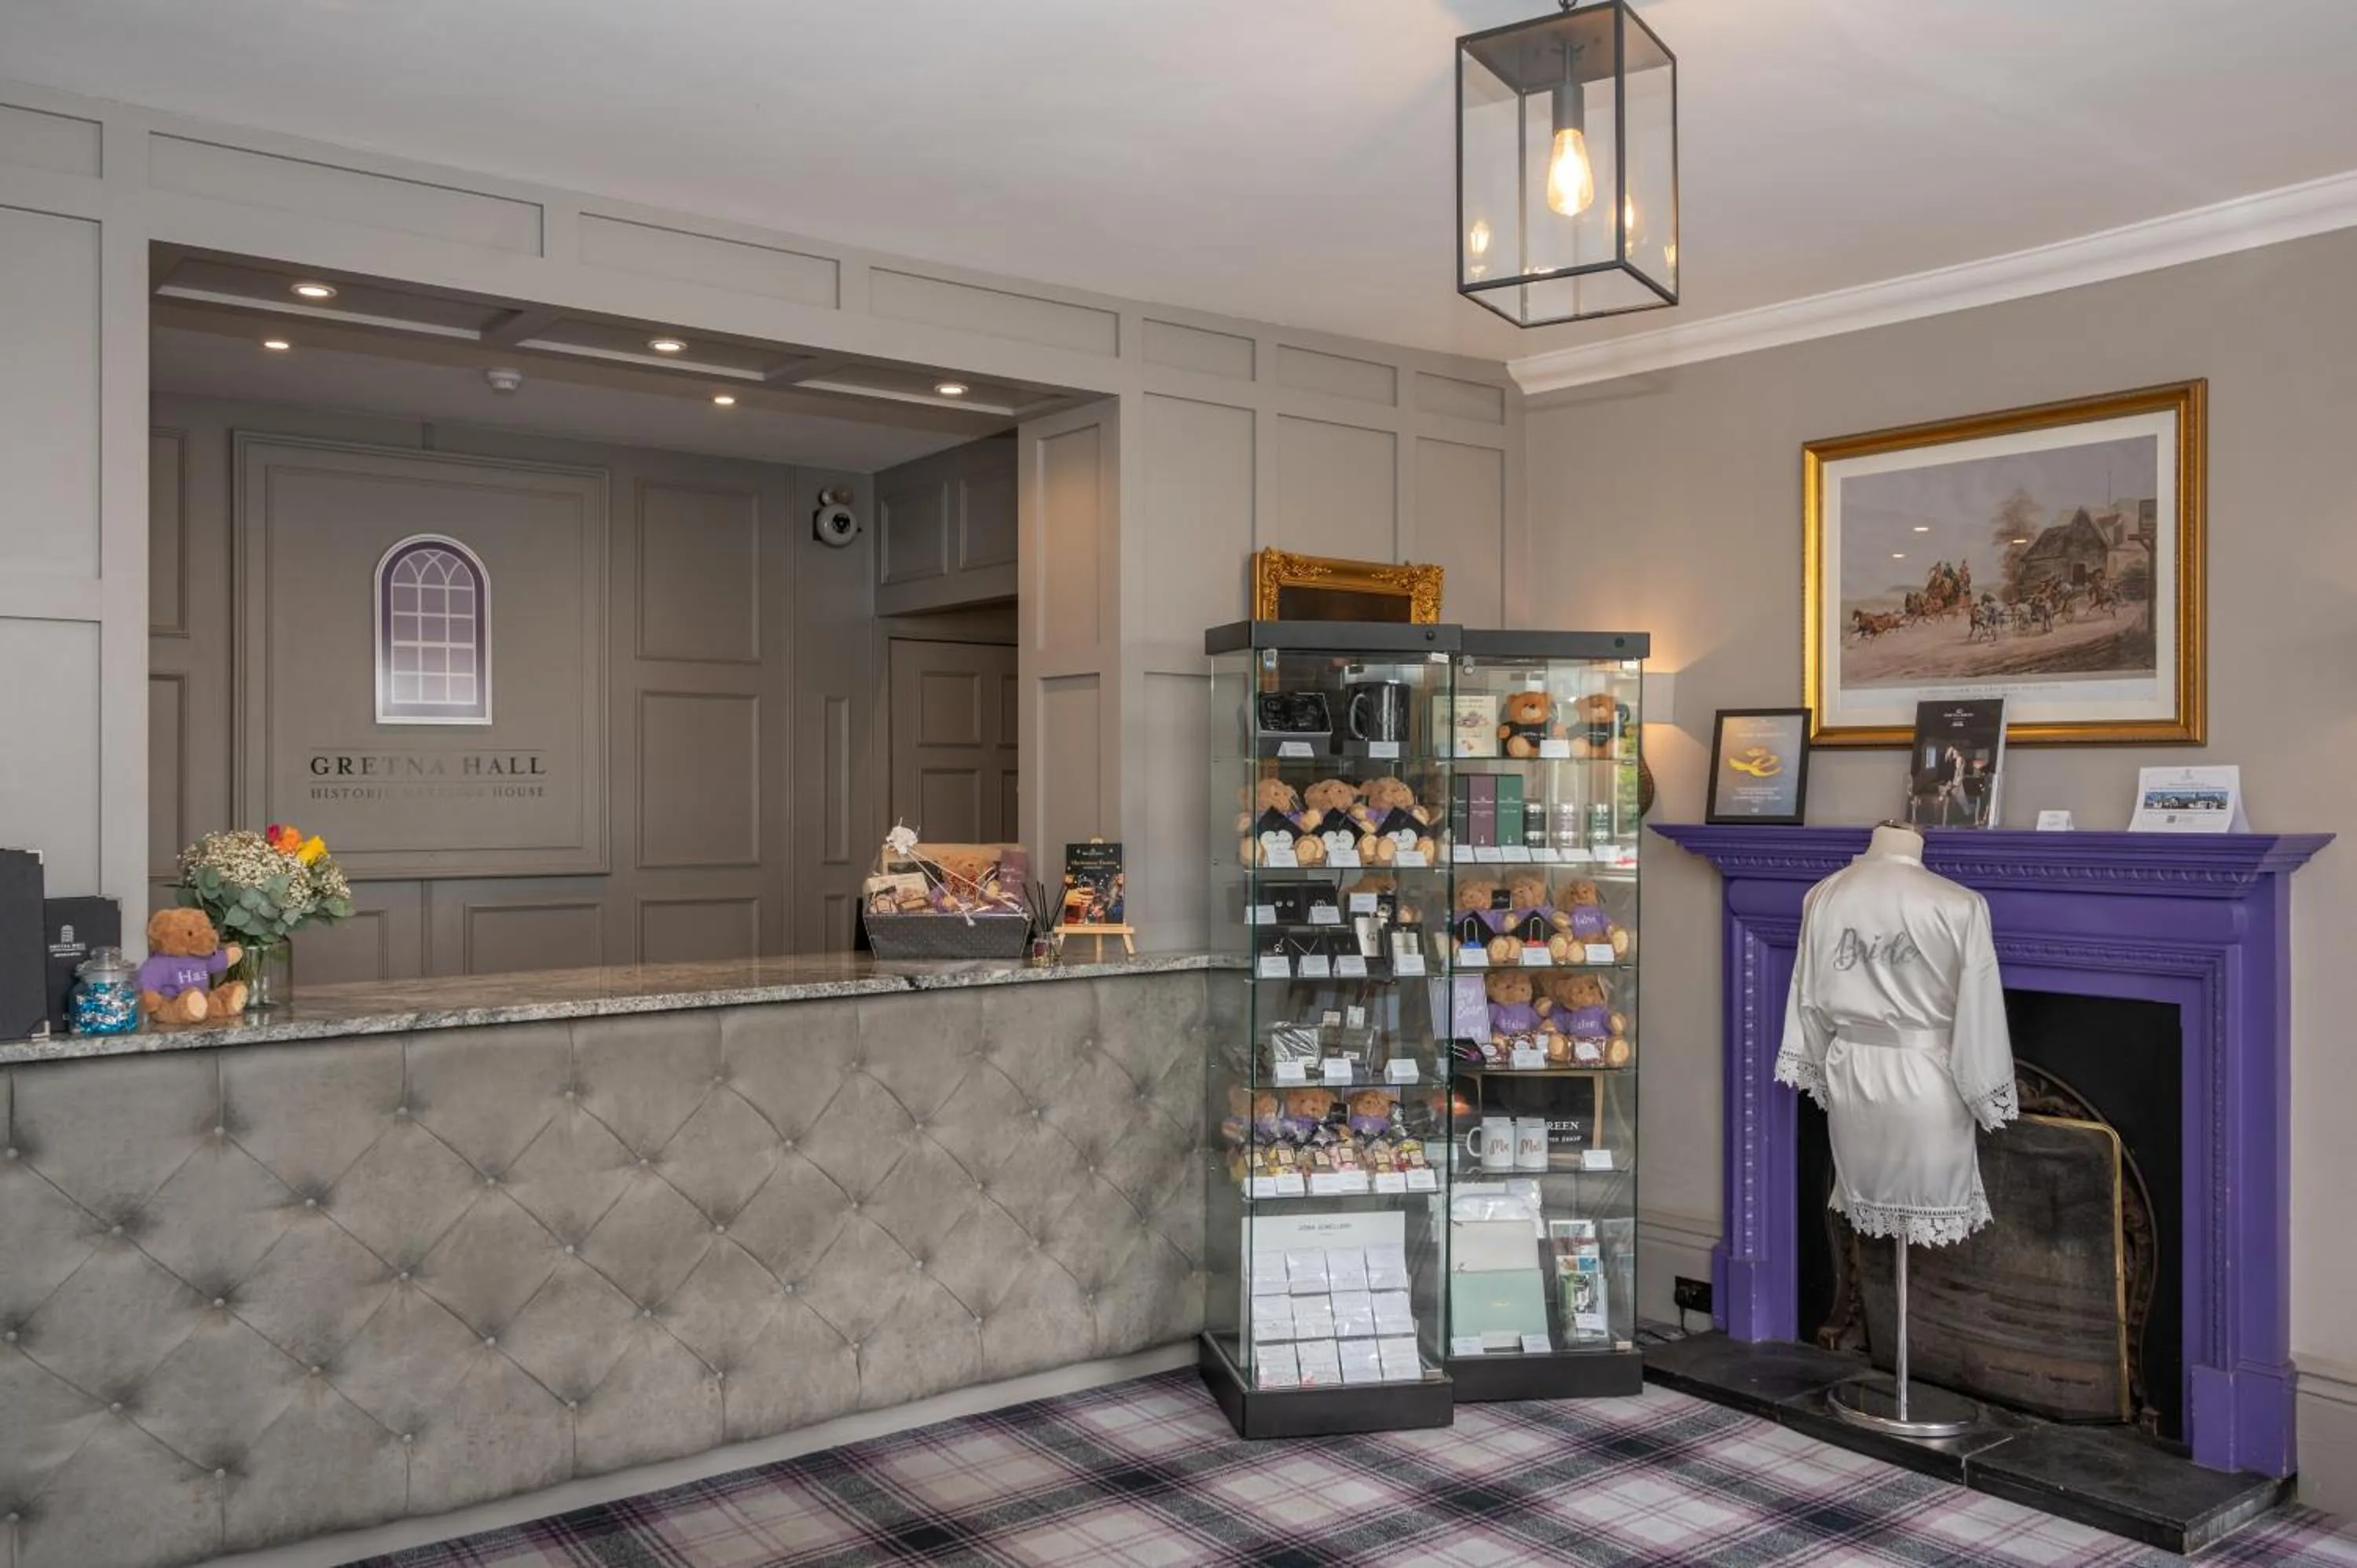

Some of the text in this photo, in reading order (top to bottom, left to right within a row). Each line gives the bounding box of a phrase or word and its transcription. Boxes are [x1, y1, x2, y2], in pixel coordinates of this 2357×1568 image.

[310, 757, 547, 775] GRETNA HALL
[493, 786, 545, 797] HOUSE
[1834, 928, 1920, 971] Bride
[1545, 1121, 1579, 1130] REEN
